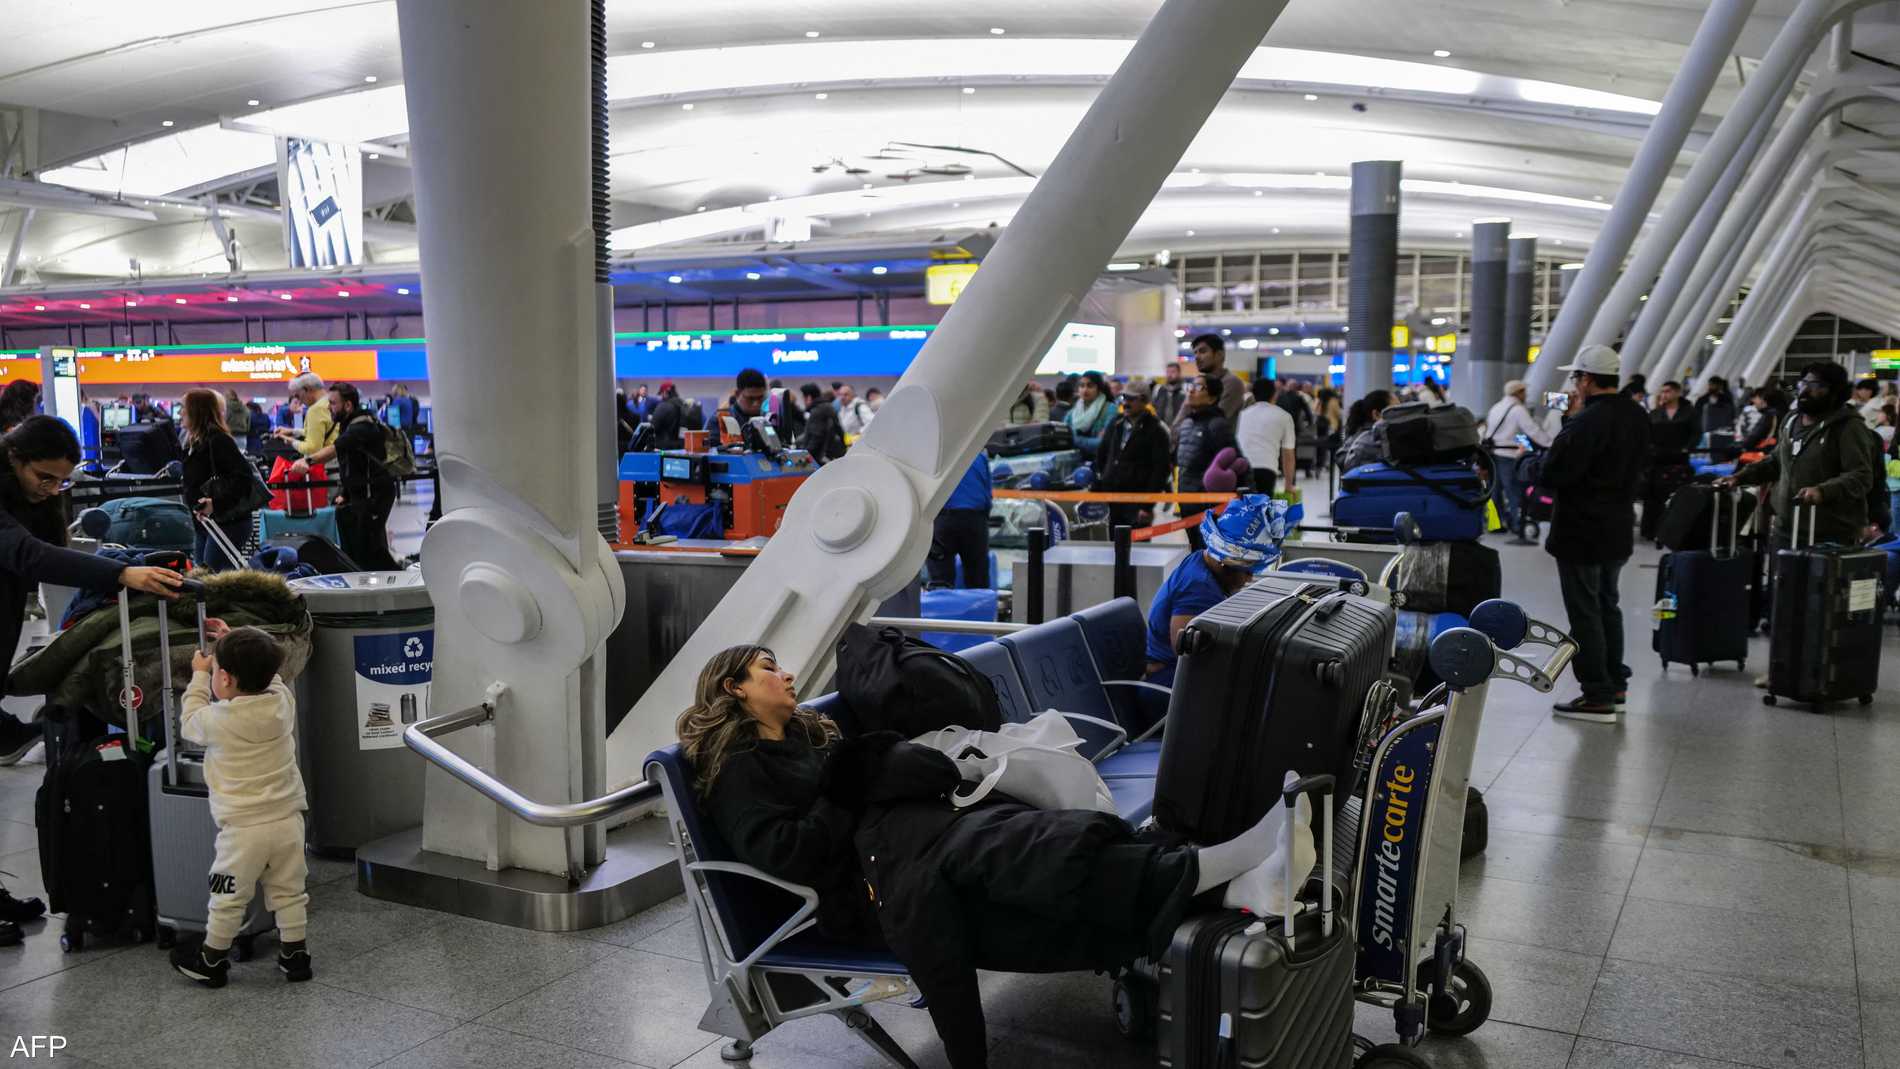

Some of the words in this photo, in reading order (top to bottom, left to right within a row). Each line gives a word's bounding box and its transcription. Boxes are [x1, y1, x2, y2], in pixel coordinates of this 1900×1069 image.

[370, 662, 406, 675] mixed
[409, 660, 433, 673] recy
[1372, 764, 1415, 951] smartecarte
